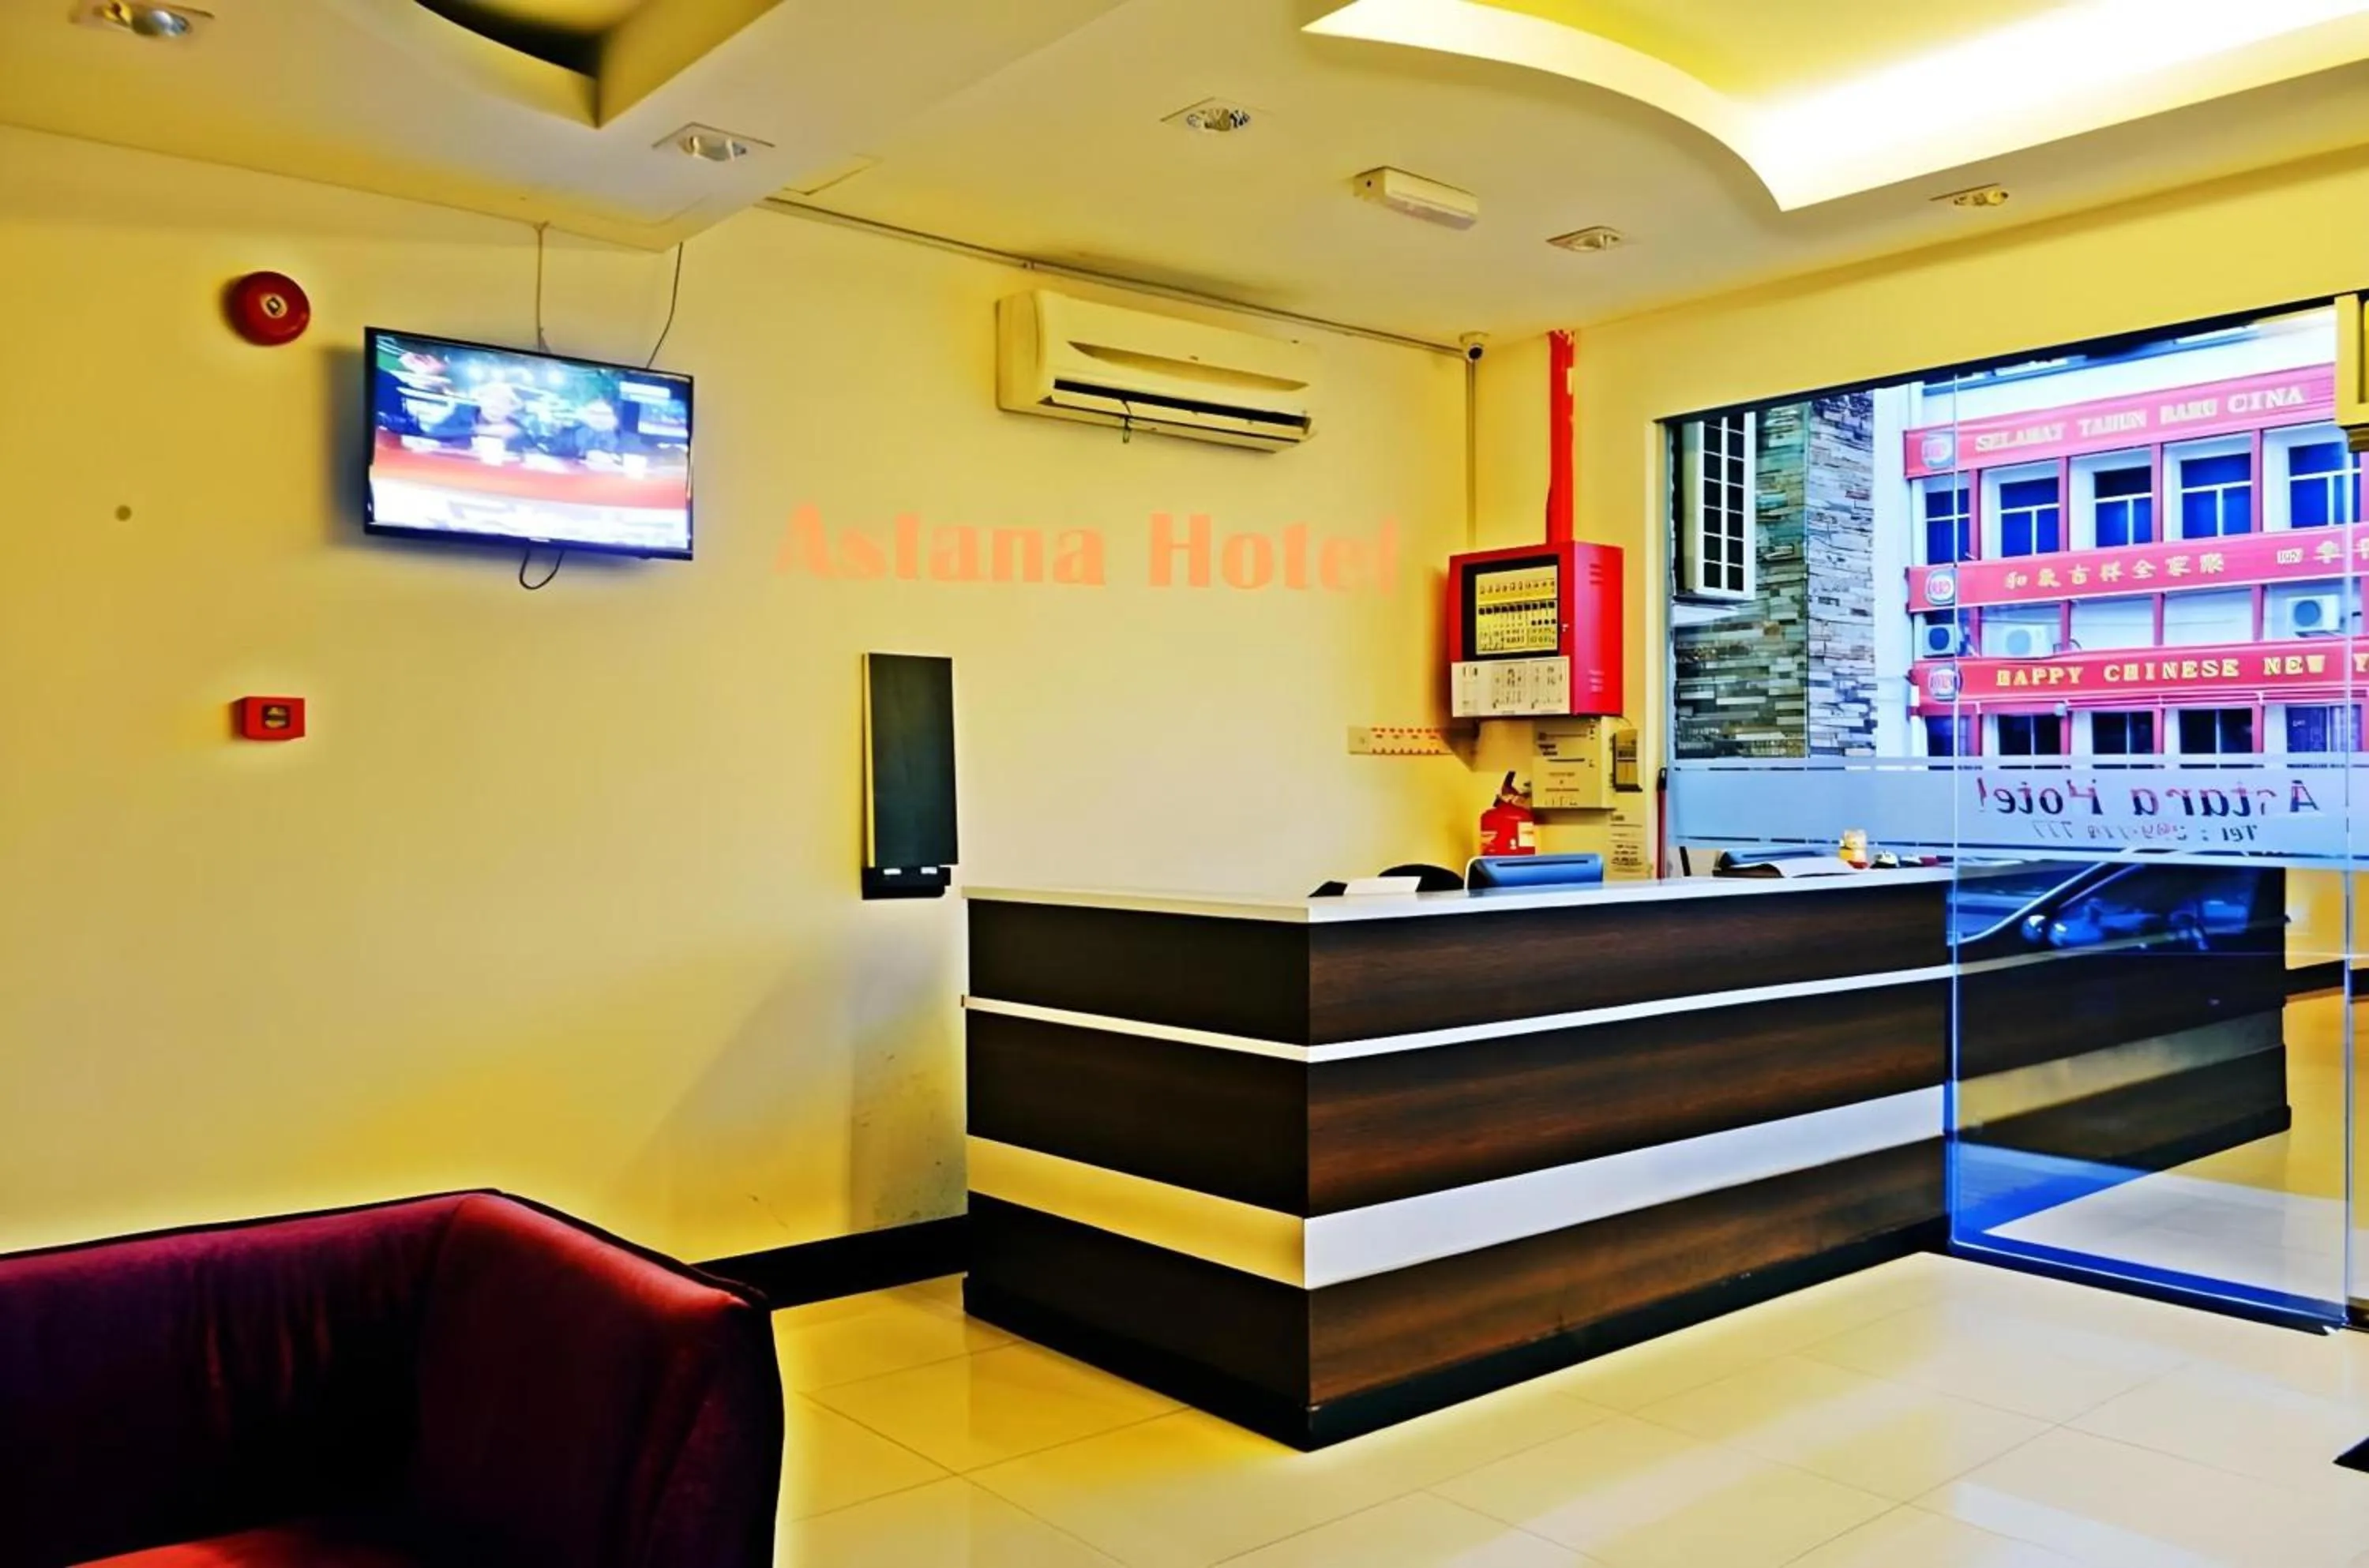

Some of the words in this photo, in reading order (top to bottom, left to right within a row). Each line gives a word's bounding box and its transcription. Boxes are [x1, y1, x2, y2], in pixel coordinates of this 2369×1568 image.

[2227, 386, 2304, 414] CINA
[773, 501, 1106, 586] Astana
[1147, 512, 1398, 597] Hotel
[1995, 666, 2083, 687] HAPPY
[2103, 658, 2239, 681] CHINESE
[2263, 655, 2326, 676] NEW
